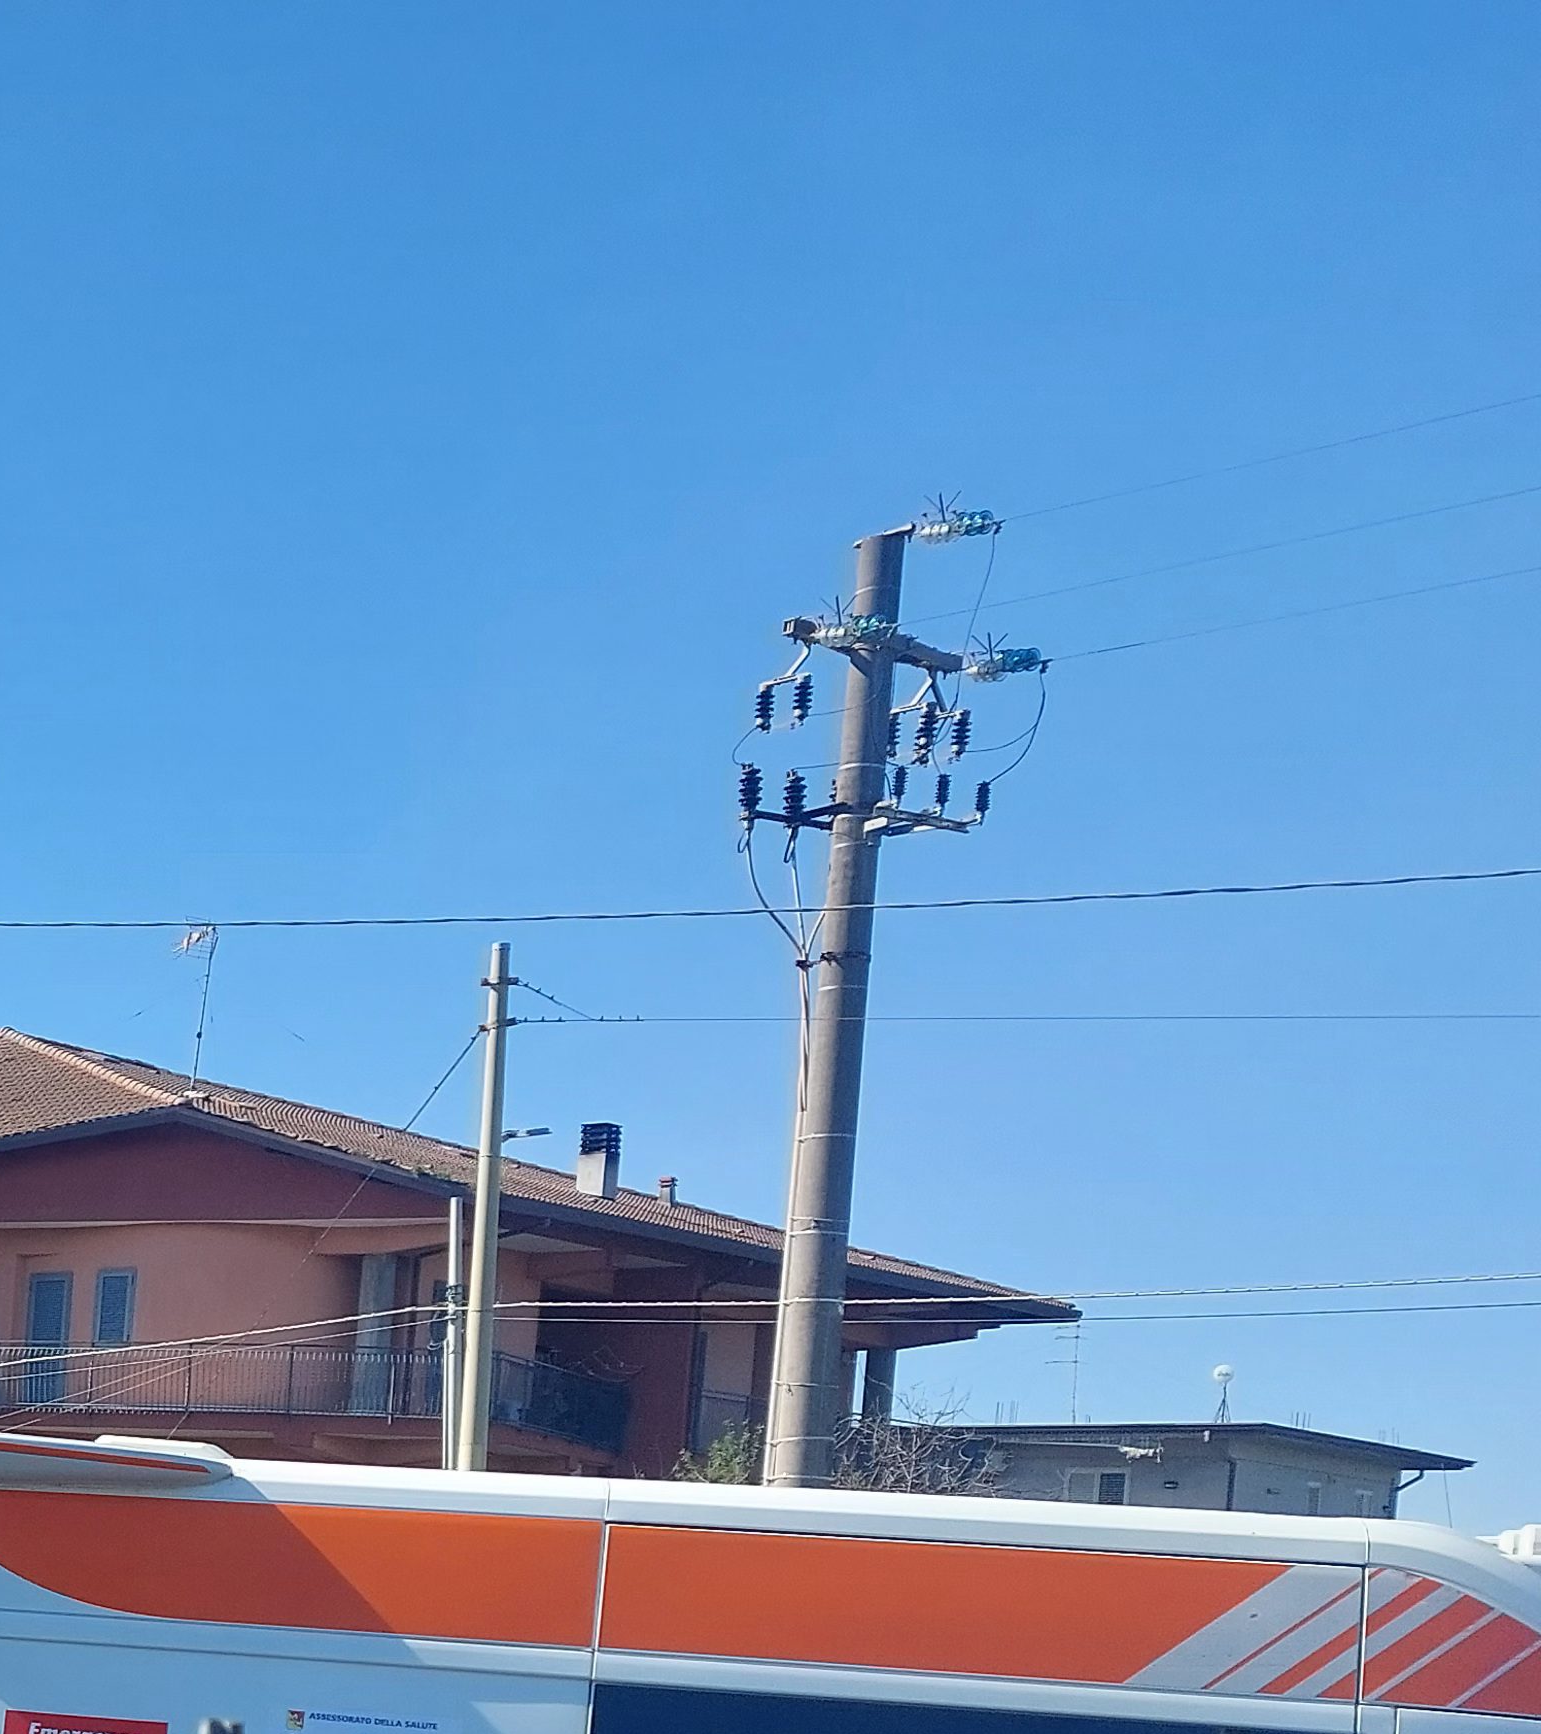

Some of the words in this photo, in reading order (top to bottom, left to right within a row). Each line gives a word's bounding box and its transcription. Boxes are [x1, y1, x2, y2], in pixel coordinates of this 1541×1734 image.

[309, 1712, 372, 1725] ASSESSORATO
[374, 1718, 402, 1728] DELLA
[405, 1721, 438, 1730] SALUTE
